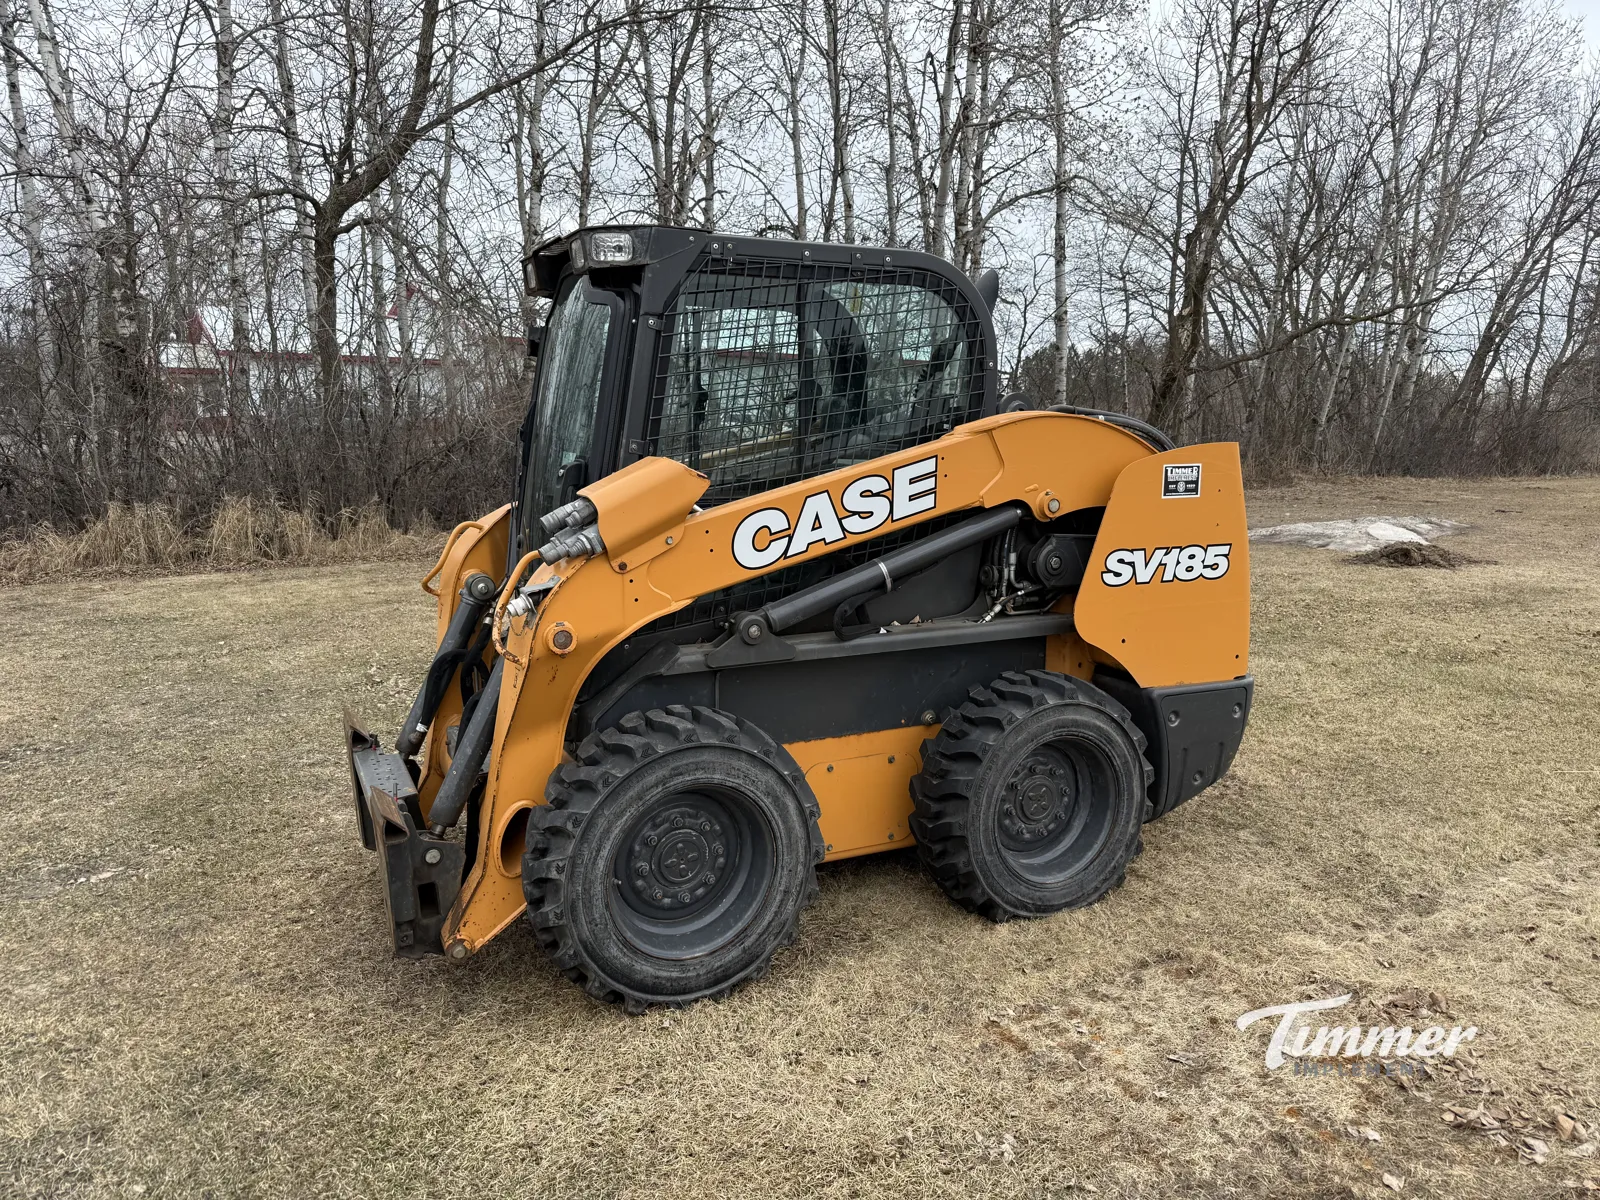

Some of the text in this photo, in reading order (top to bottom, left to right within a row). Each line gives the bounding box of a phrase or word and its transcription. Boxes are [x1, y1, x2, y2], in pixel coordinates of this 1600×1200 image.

[1166, 466, 1198, 476] TIMMER
[732, 455, 938, 570] CASE
[1101, 543, 1232, 587] SV185
